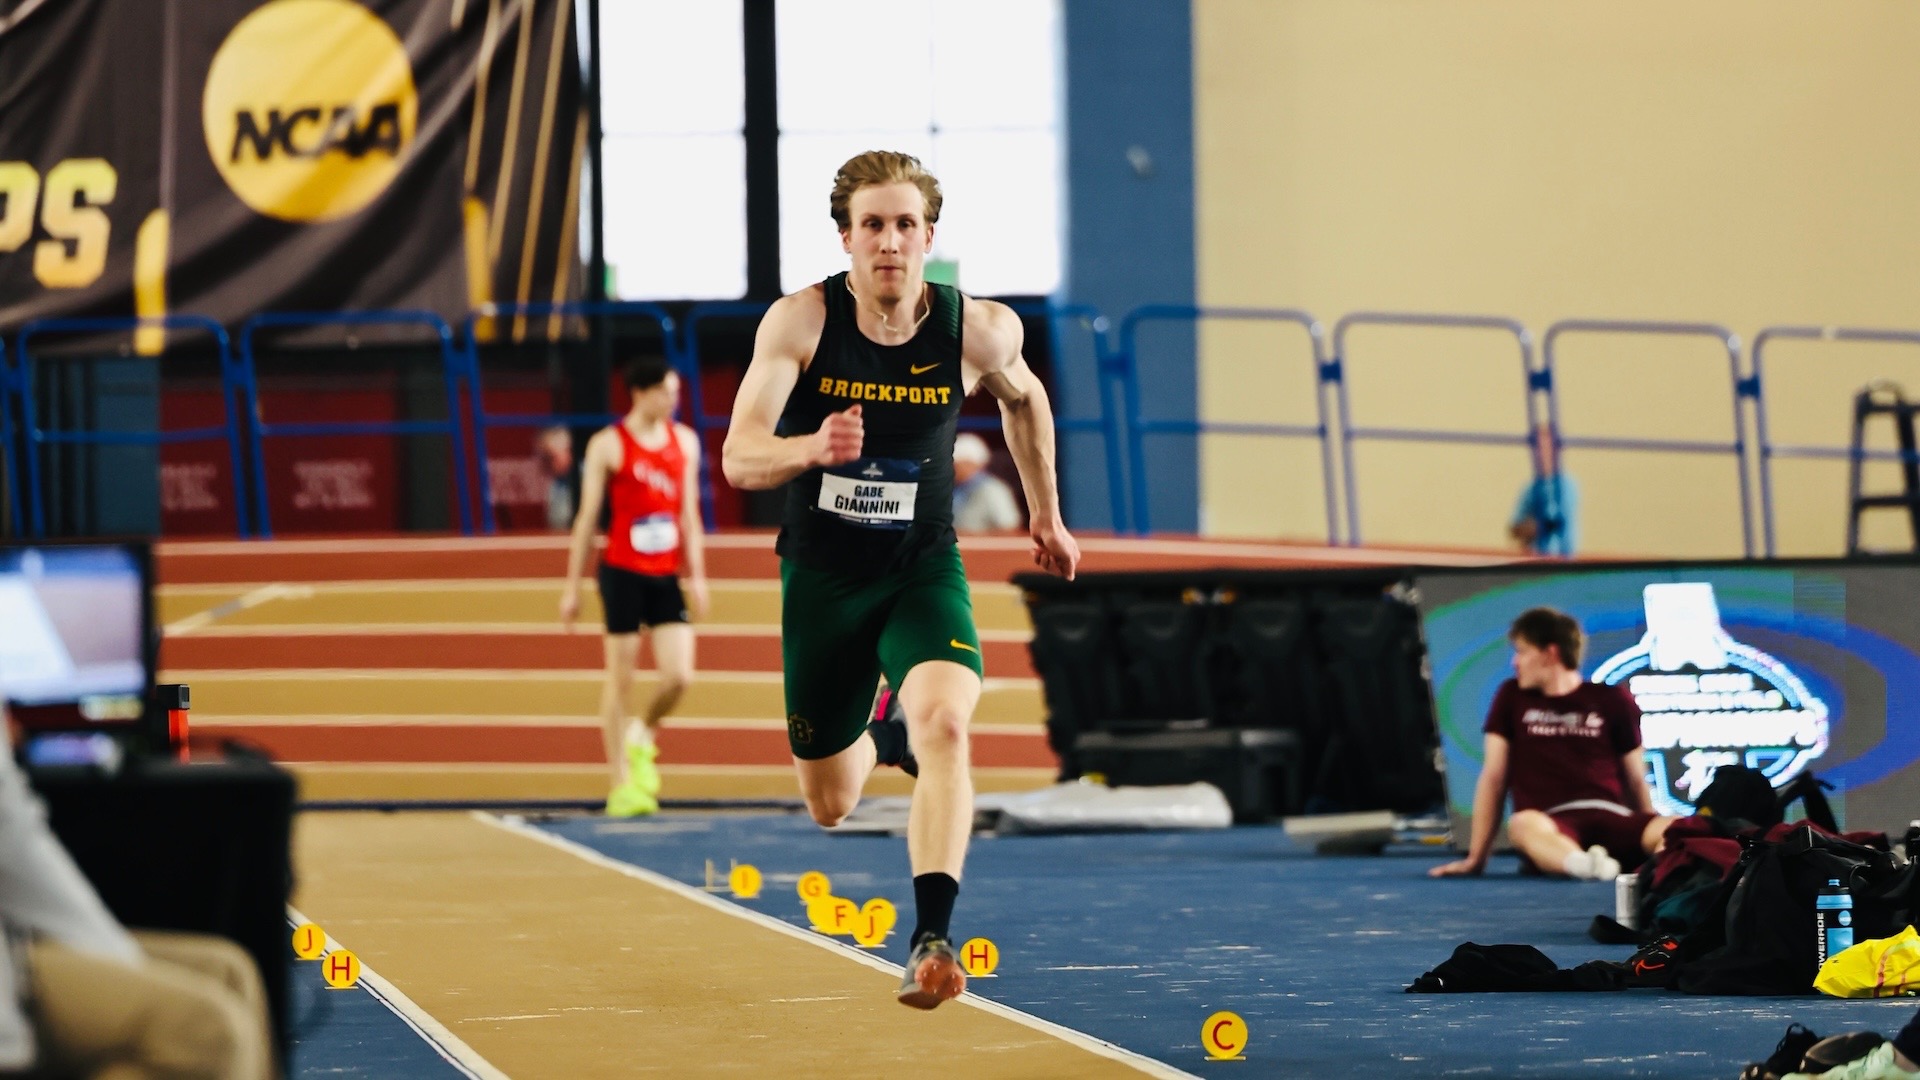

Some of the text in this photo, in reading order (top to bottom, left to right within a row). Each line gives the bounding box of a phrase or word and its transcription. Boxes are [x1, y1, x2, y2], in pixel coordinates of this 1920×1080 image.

[230, 103, 401, 163] NCAA
[819, 376, 951, 405] BROCKPORT
[854, 485, 885, 498] GABE
[834, 495, 900, 514] GIANNINI
[803, 876, 820, 897] G
[834, 905, 847, 928] F
[863, 915, 874, 939] J
[302, 928, 312, 952] J
[1816, 912, 1825, 971] OWERADE
[331, 955, 351, 981] H
[969, 944, 988, 969] H
[1212, 1020, 1235, 1051] C
